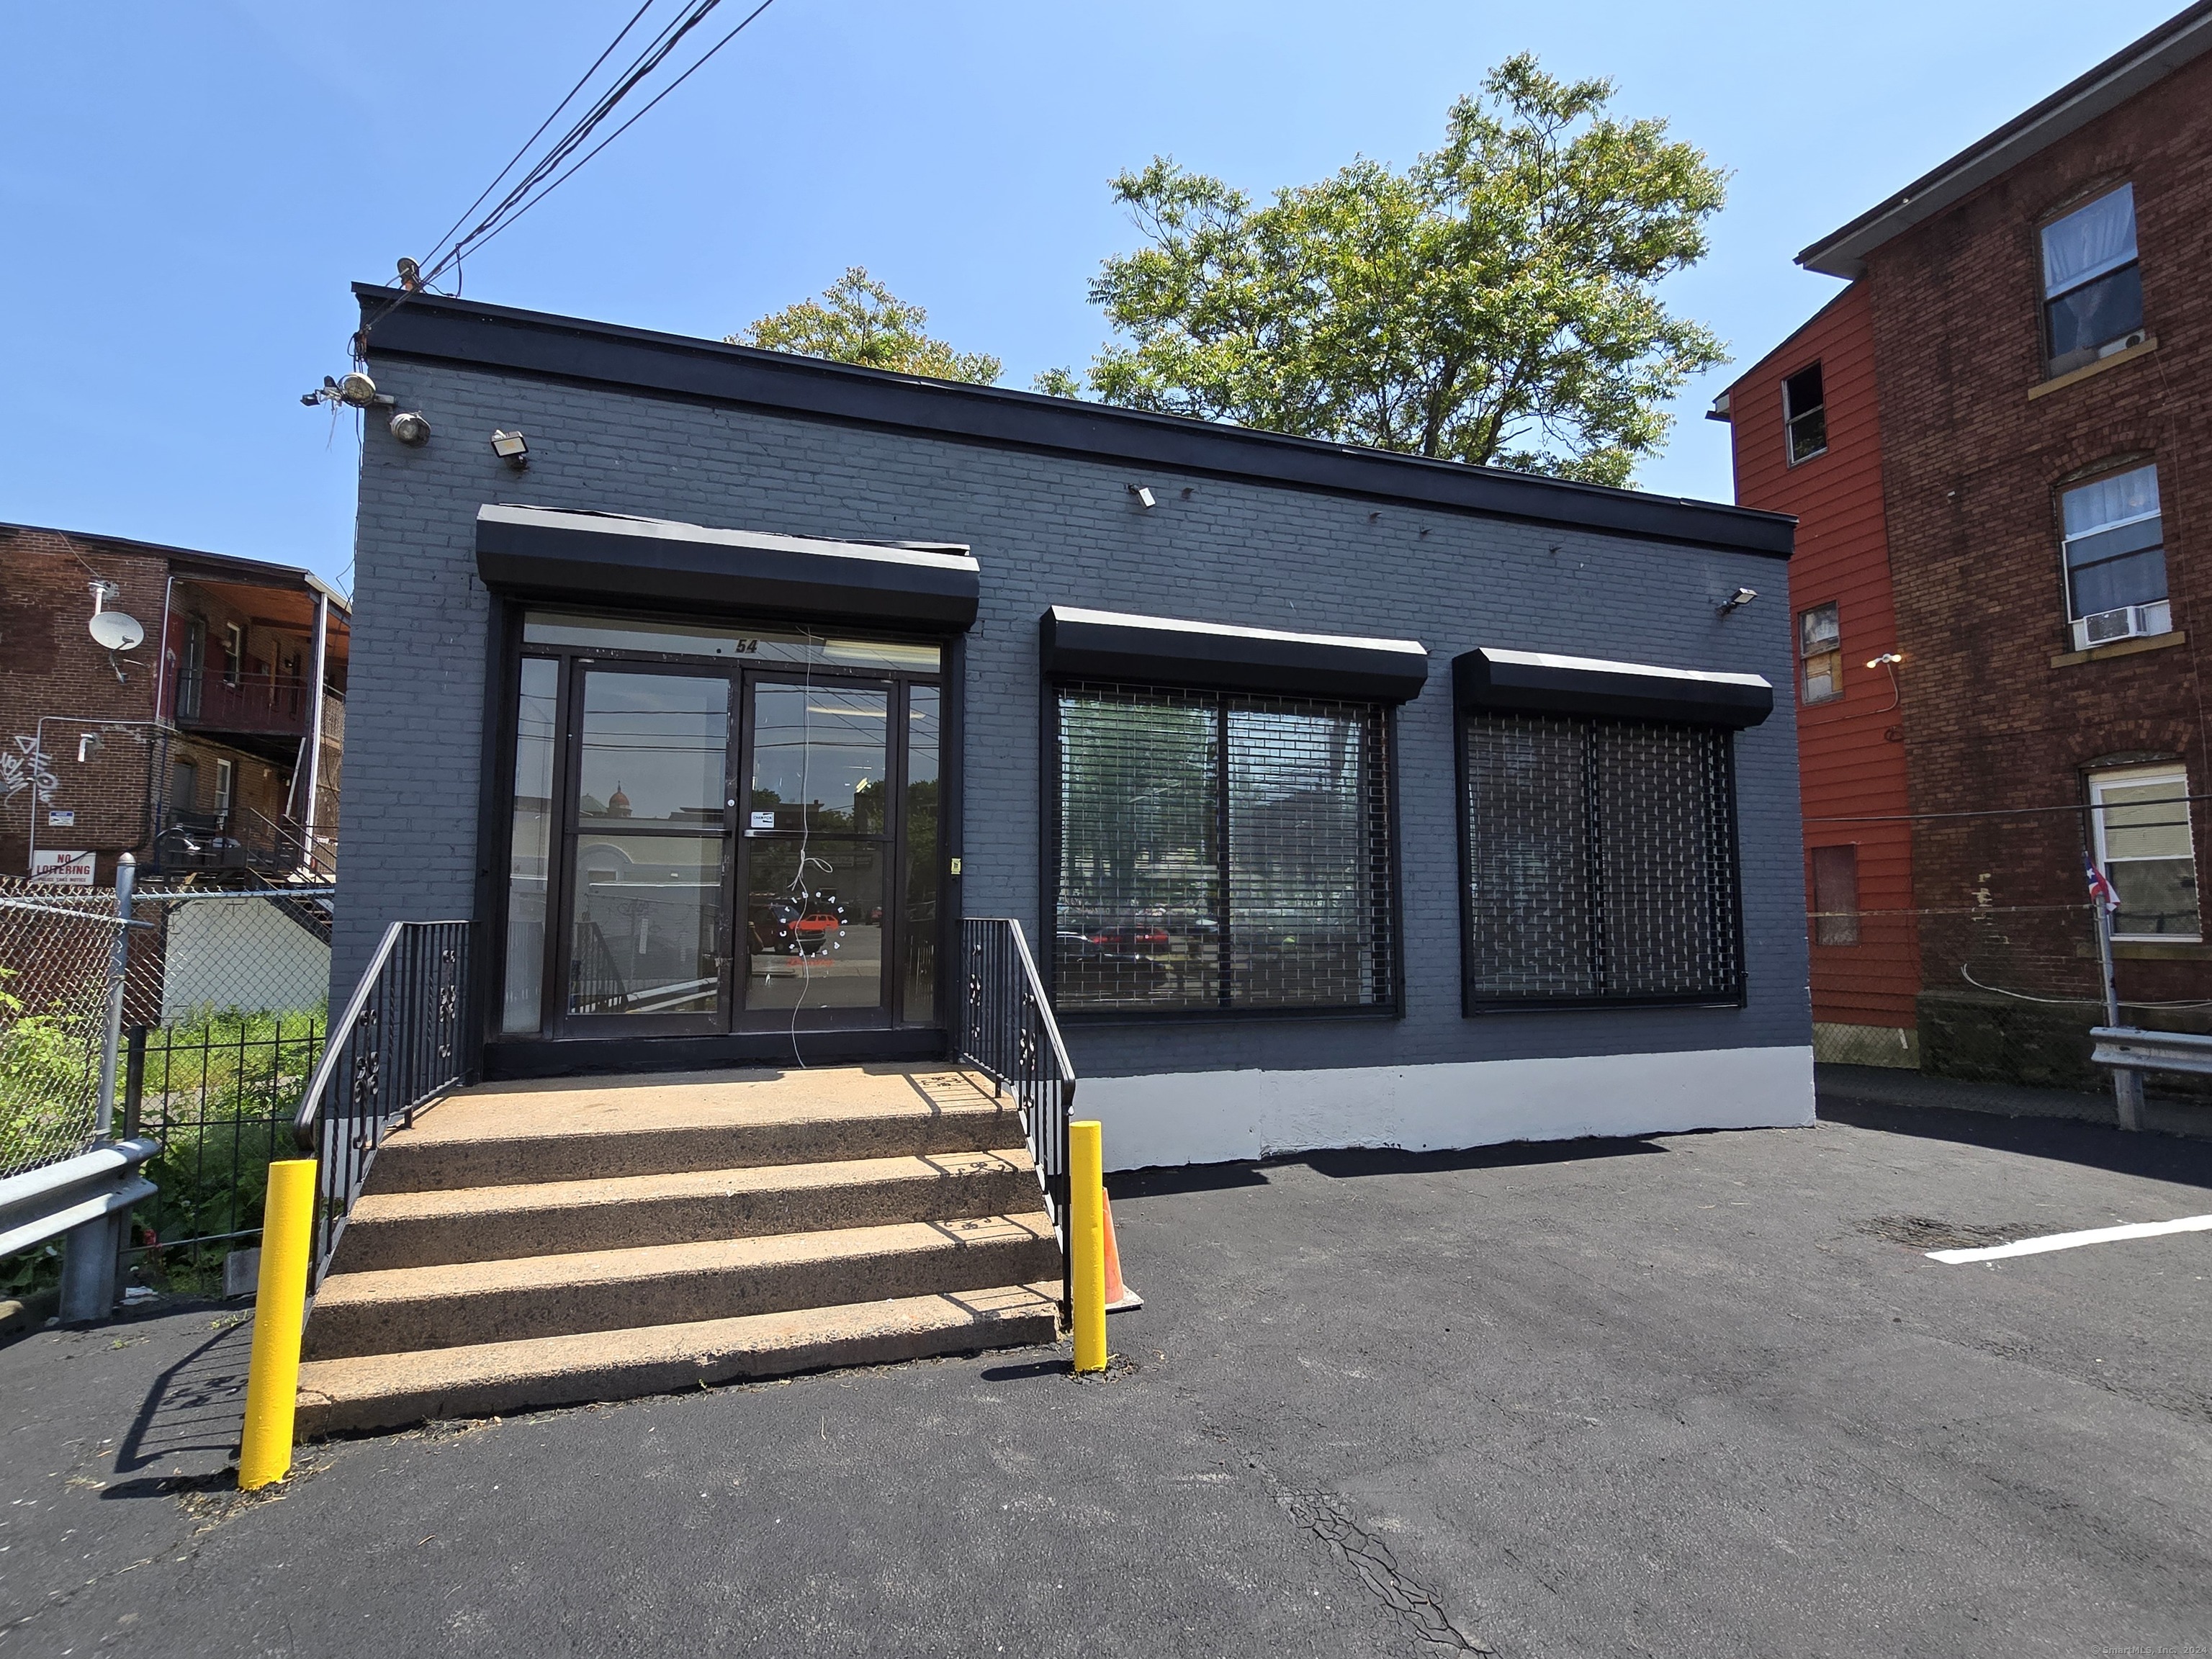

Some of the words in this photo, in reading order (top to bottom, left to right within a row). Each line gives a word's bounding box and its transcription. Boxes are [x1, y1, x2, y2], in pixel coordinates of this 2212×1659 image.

[736, 639, 758, 653] 54
[58, 854, 71, 863] NO
[37, 866, 90, 875] LOITERING
